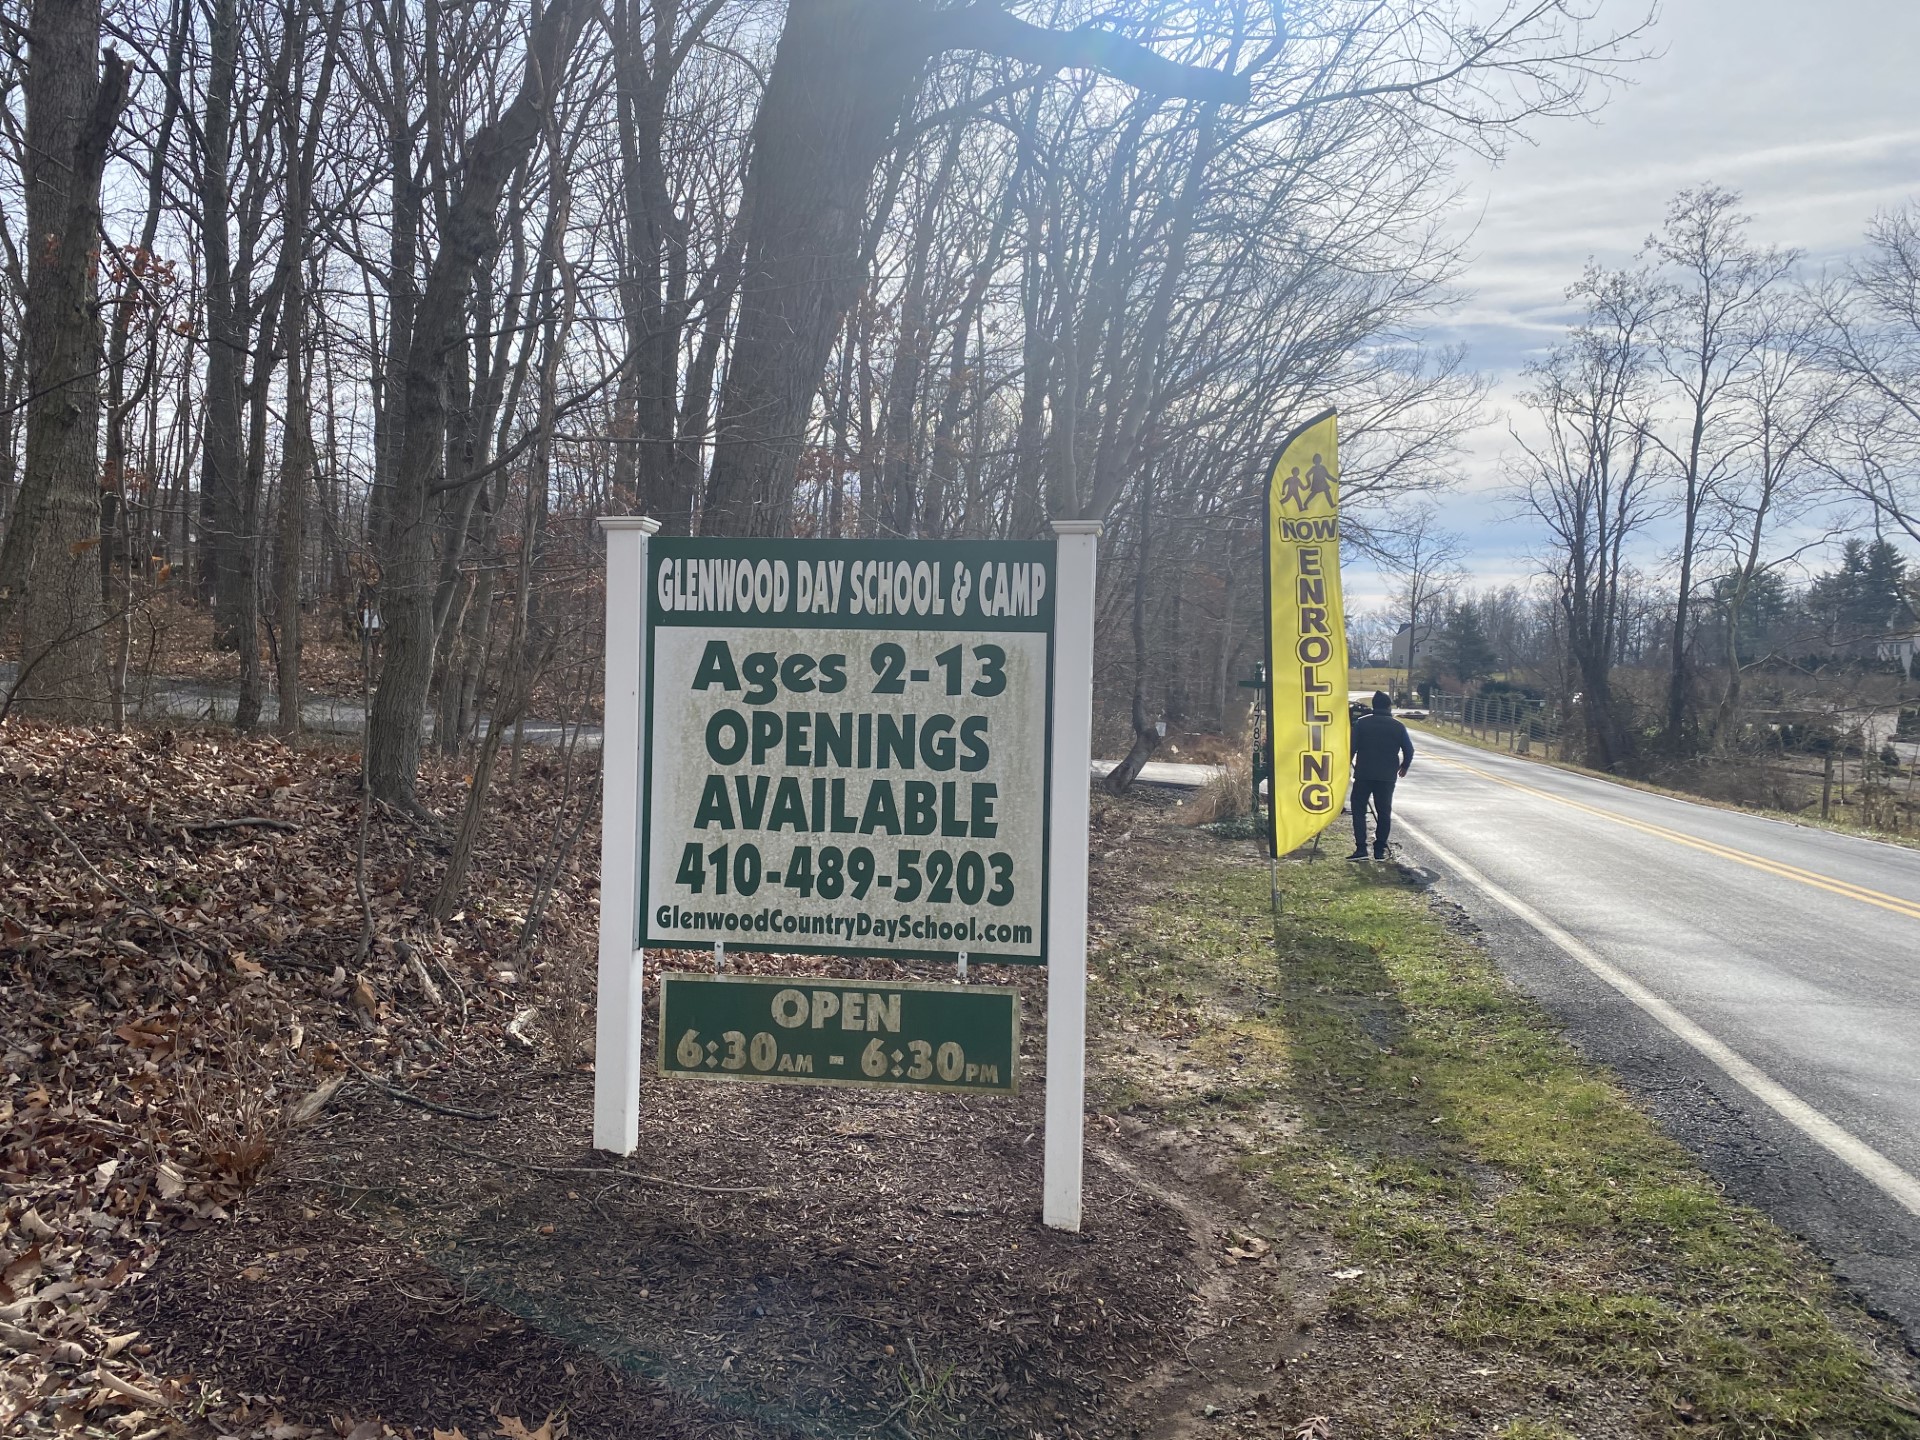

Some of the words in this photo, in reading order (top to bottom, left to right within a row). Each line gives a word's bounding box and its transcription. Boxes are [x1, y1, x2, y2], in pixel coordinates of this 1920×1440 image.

[1281, 517, 1337, 541] NOW
[658, 557, 790, 613] GLENWOOD
[797, 560, 844, 614] DAY
[850, 560, 944, 616] SCHOOL
[951, 560, 972, 617] &
[978, 561, 1046, 617] CAMP
[691, 640, 847, 705] Ages
[870, 642, 1007, 697] 2-13
[1298, 549, 1331, 812] ENROLLING
[705, 708, 990, 772] OPENINGS
[1252, 688, 1261, 752] 14785
[693, 774, 999, 838] AVAILABLE
[675, 842, 1015, 906] 410-489-5203
[656, 905, 1032, 944] GlenwoodCountryDaySchool.com
[770, 989, 901, 1033] OPEN
